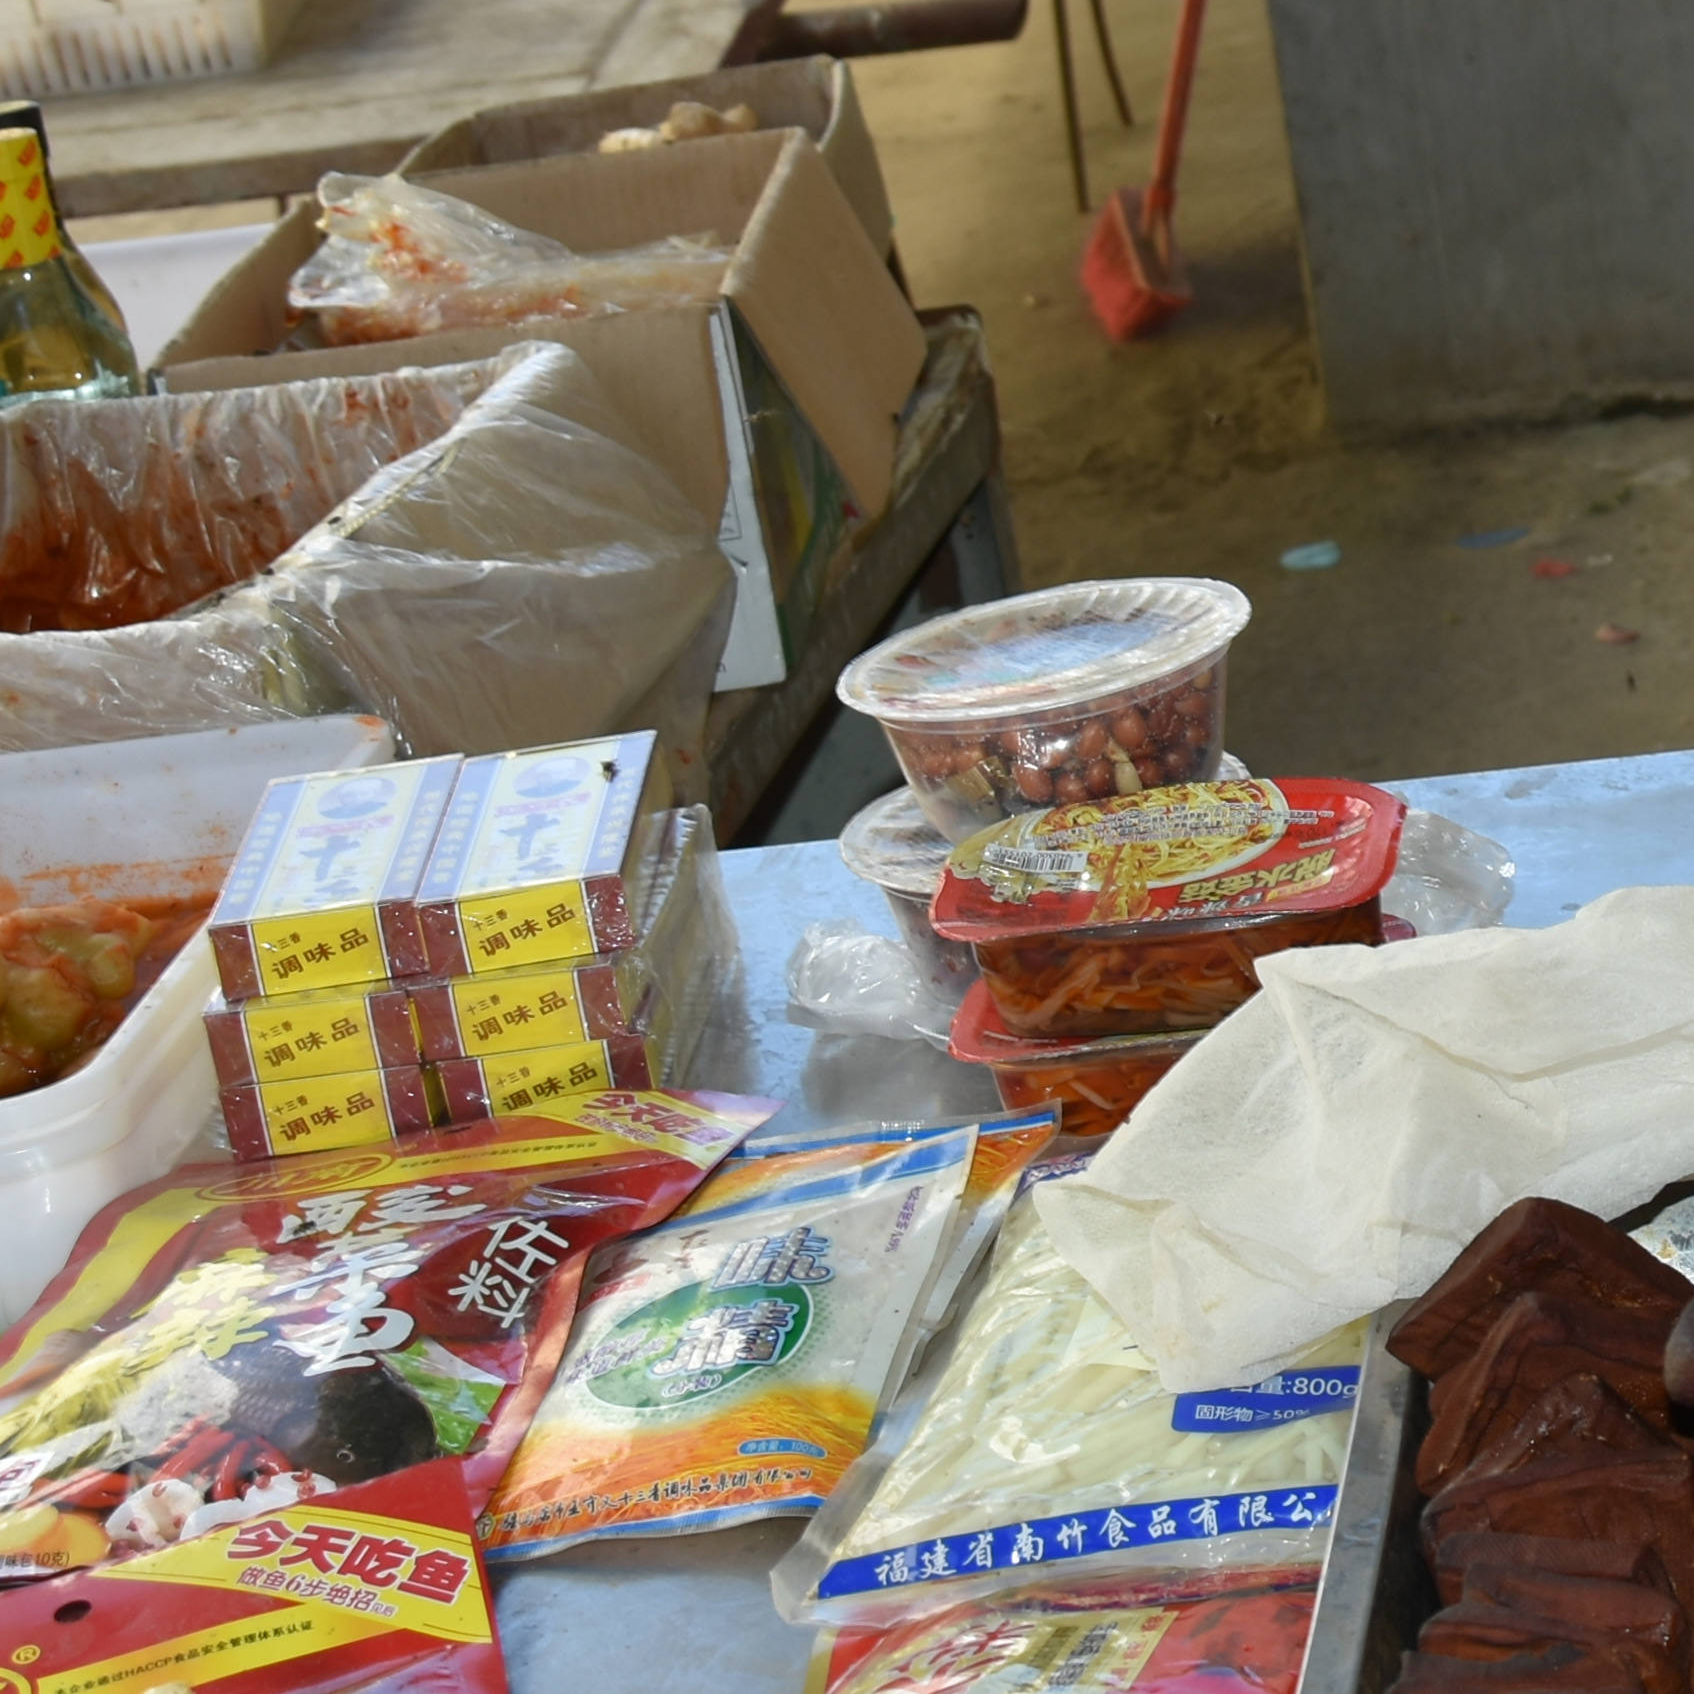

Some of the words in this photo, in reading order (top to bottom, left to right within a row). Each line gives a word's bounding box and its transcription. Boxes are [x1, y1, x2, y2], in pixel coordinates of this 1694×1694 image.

[474, 907, 510, 932] 十三香
[479, 902, 576, 958] 调味品
[271, 927, 370, 980] 调味品
[257, 1019, 294, 1042] 十三香
[465, 993, 502, 1016] 十三香
[471, 990, 569, 1042] 调味品
[263, 1016, 360, 1069] 调味品
[495, 1066, 532, 1090] 十三香
[501, 1061, 599, 1113] 调味品
[272, 1094, 310, 1117] 十三香
[279, 1090, 377, 1143] 调味品
[447, 1214, 571, 1330] 佐料
[648, 1225, 837, 1380] 味精
[226, 1518, 471, 1606] 今天吃鱼
[873, 1493, 1336, 1587] 福建省南竹食品有限公
[234, 1563, 381, 1614] 做鱼6步绝招
